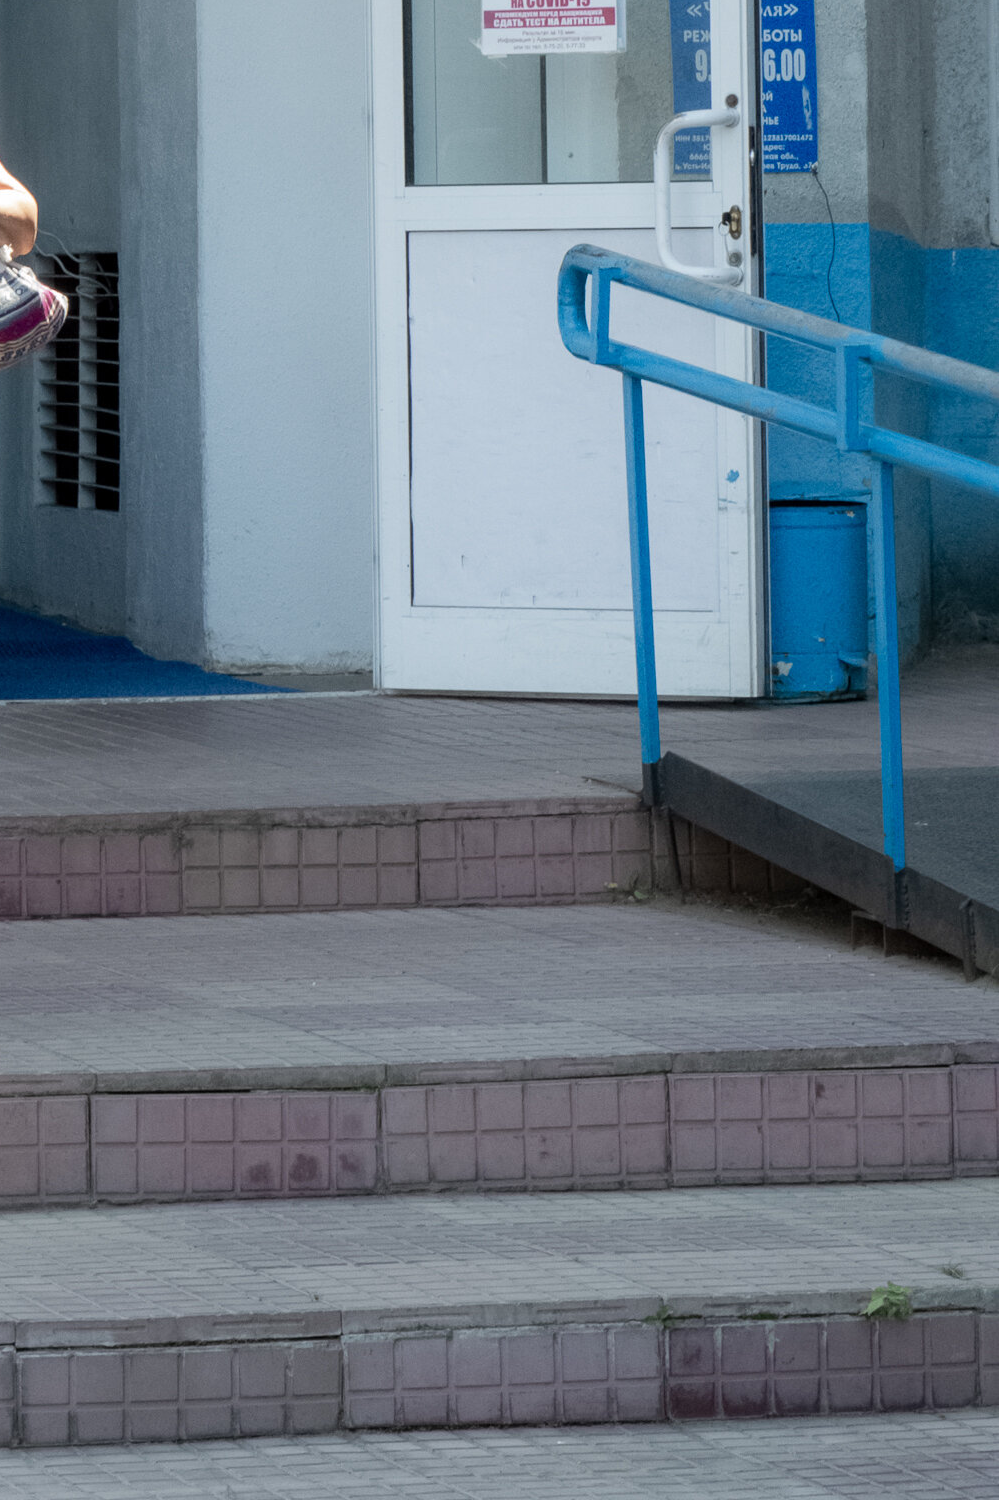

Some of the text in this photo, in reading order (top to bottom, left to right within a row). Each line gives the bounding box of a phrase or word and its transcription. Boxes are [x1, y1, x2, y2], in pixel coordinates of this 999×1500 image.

[493, 16, 606, 28] СДАТЬ ТЕСТ НА АНТИТЕЛА
[763, 48, 806, 82] 6.00
